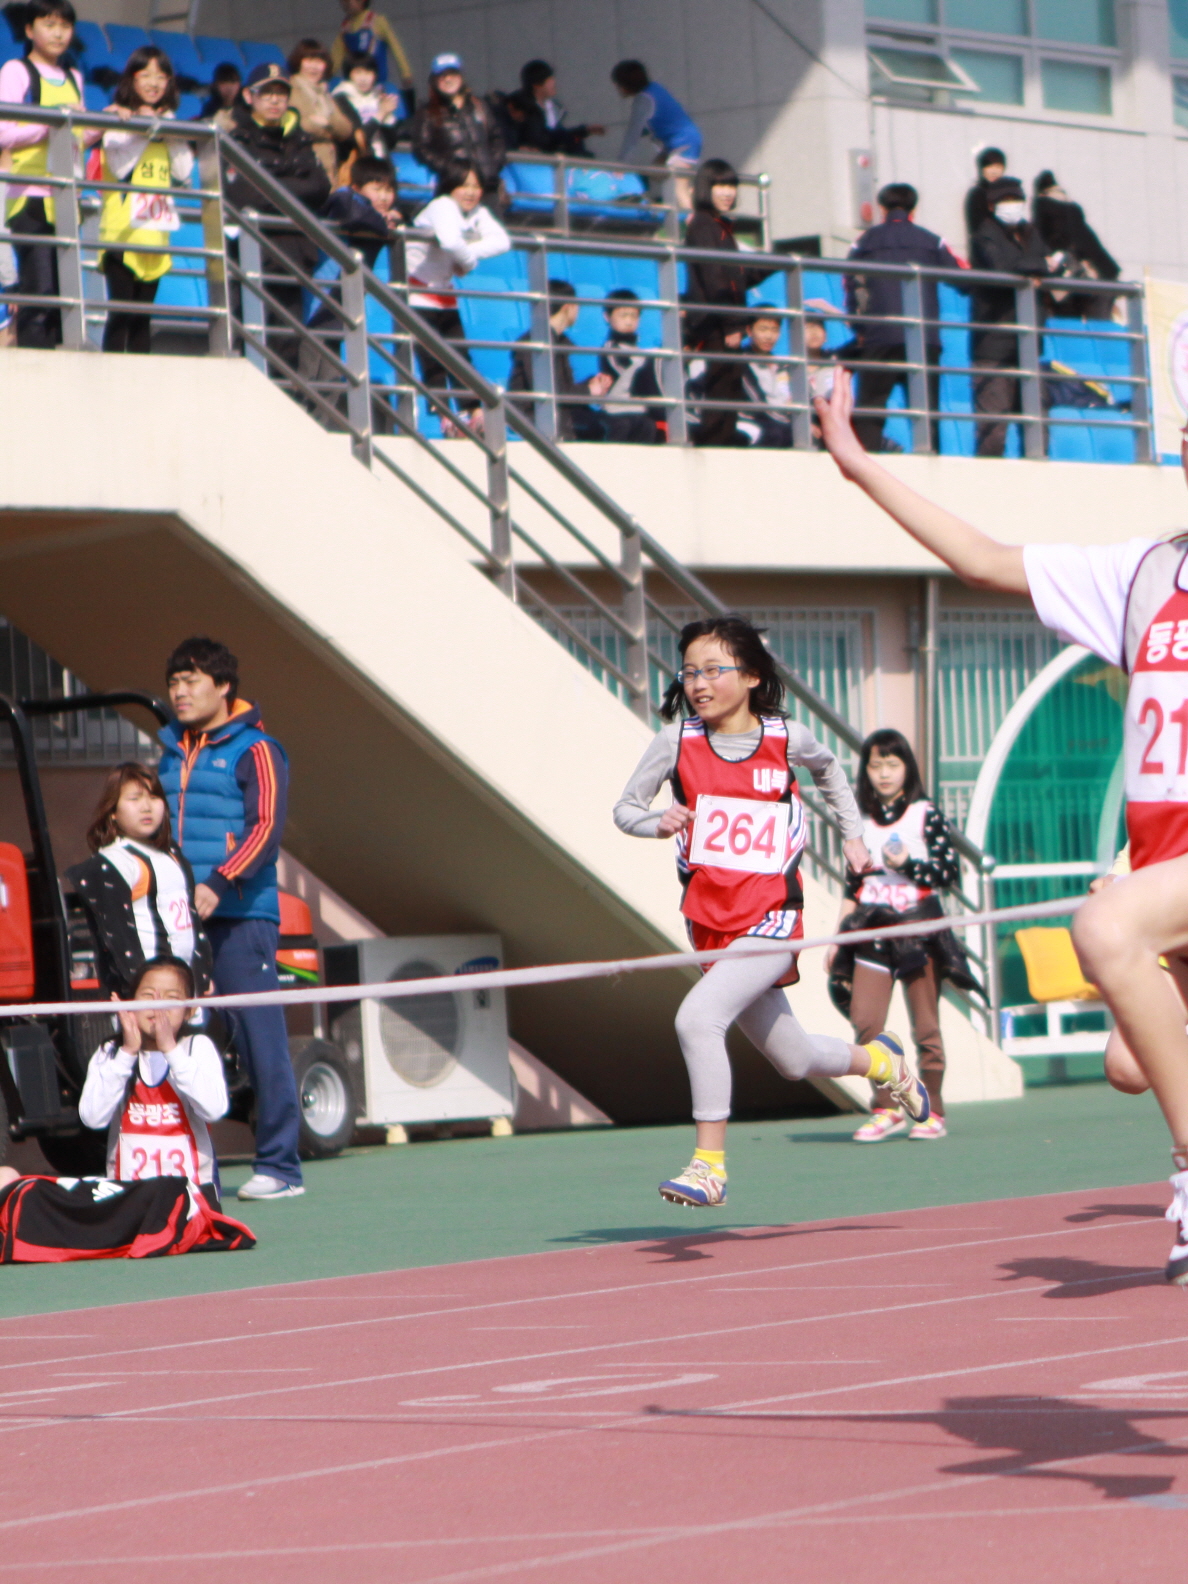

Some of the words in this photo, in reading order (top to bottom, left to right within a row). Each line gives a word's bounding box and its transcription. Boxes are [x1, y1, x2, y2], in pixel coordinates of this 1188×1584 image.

[753, 769, 788, 794] 내북
[703, 808, 776, 859] 264
[132, 1147, 187, 1180] 213
